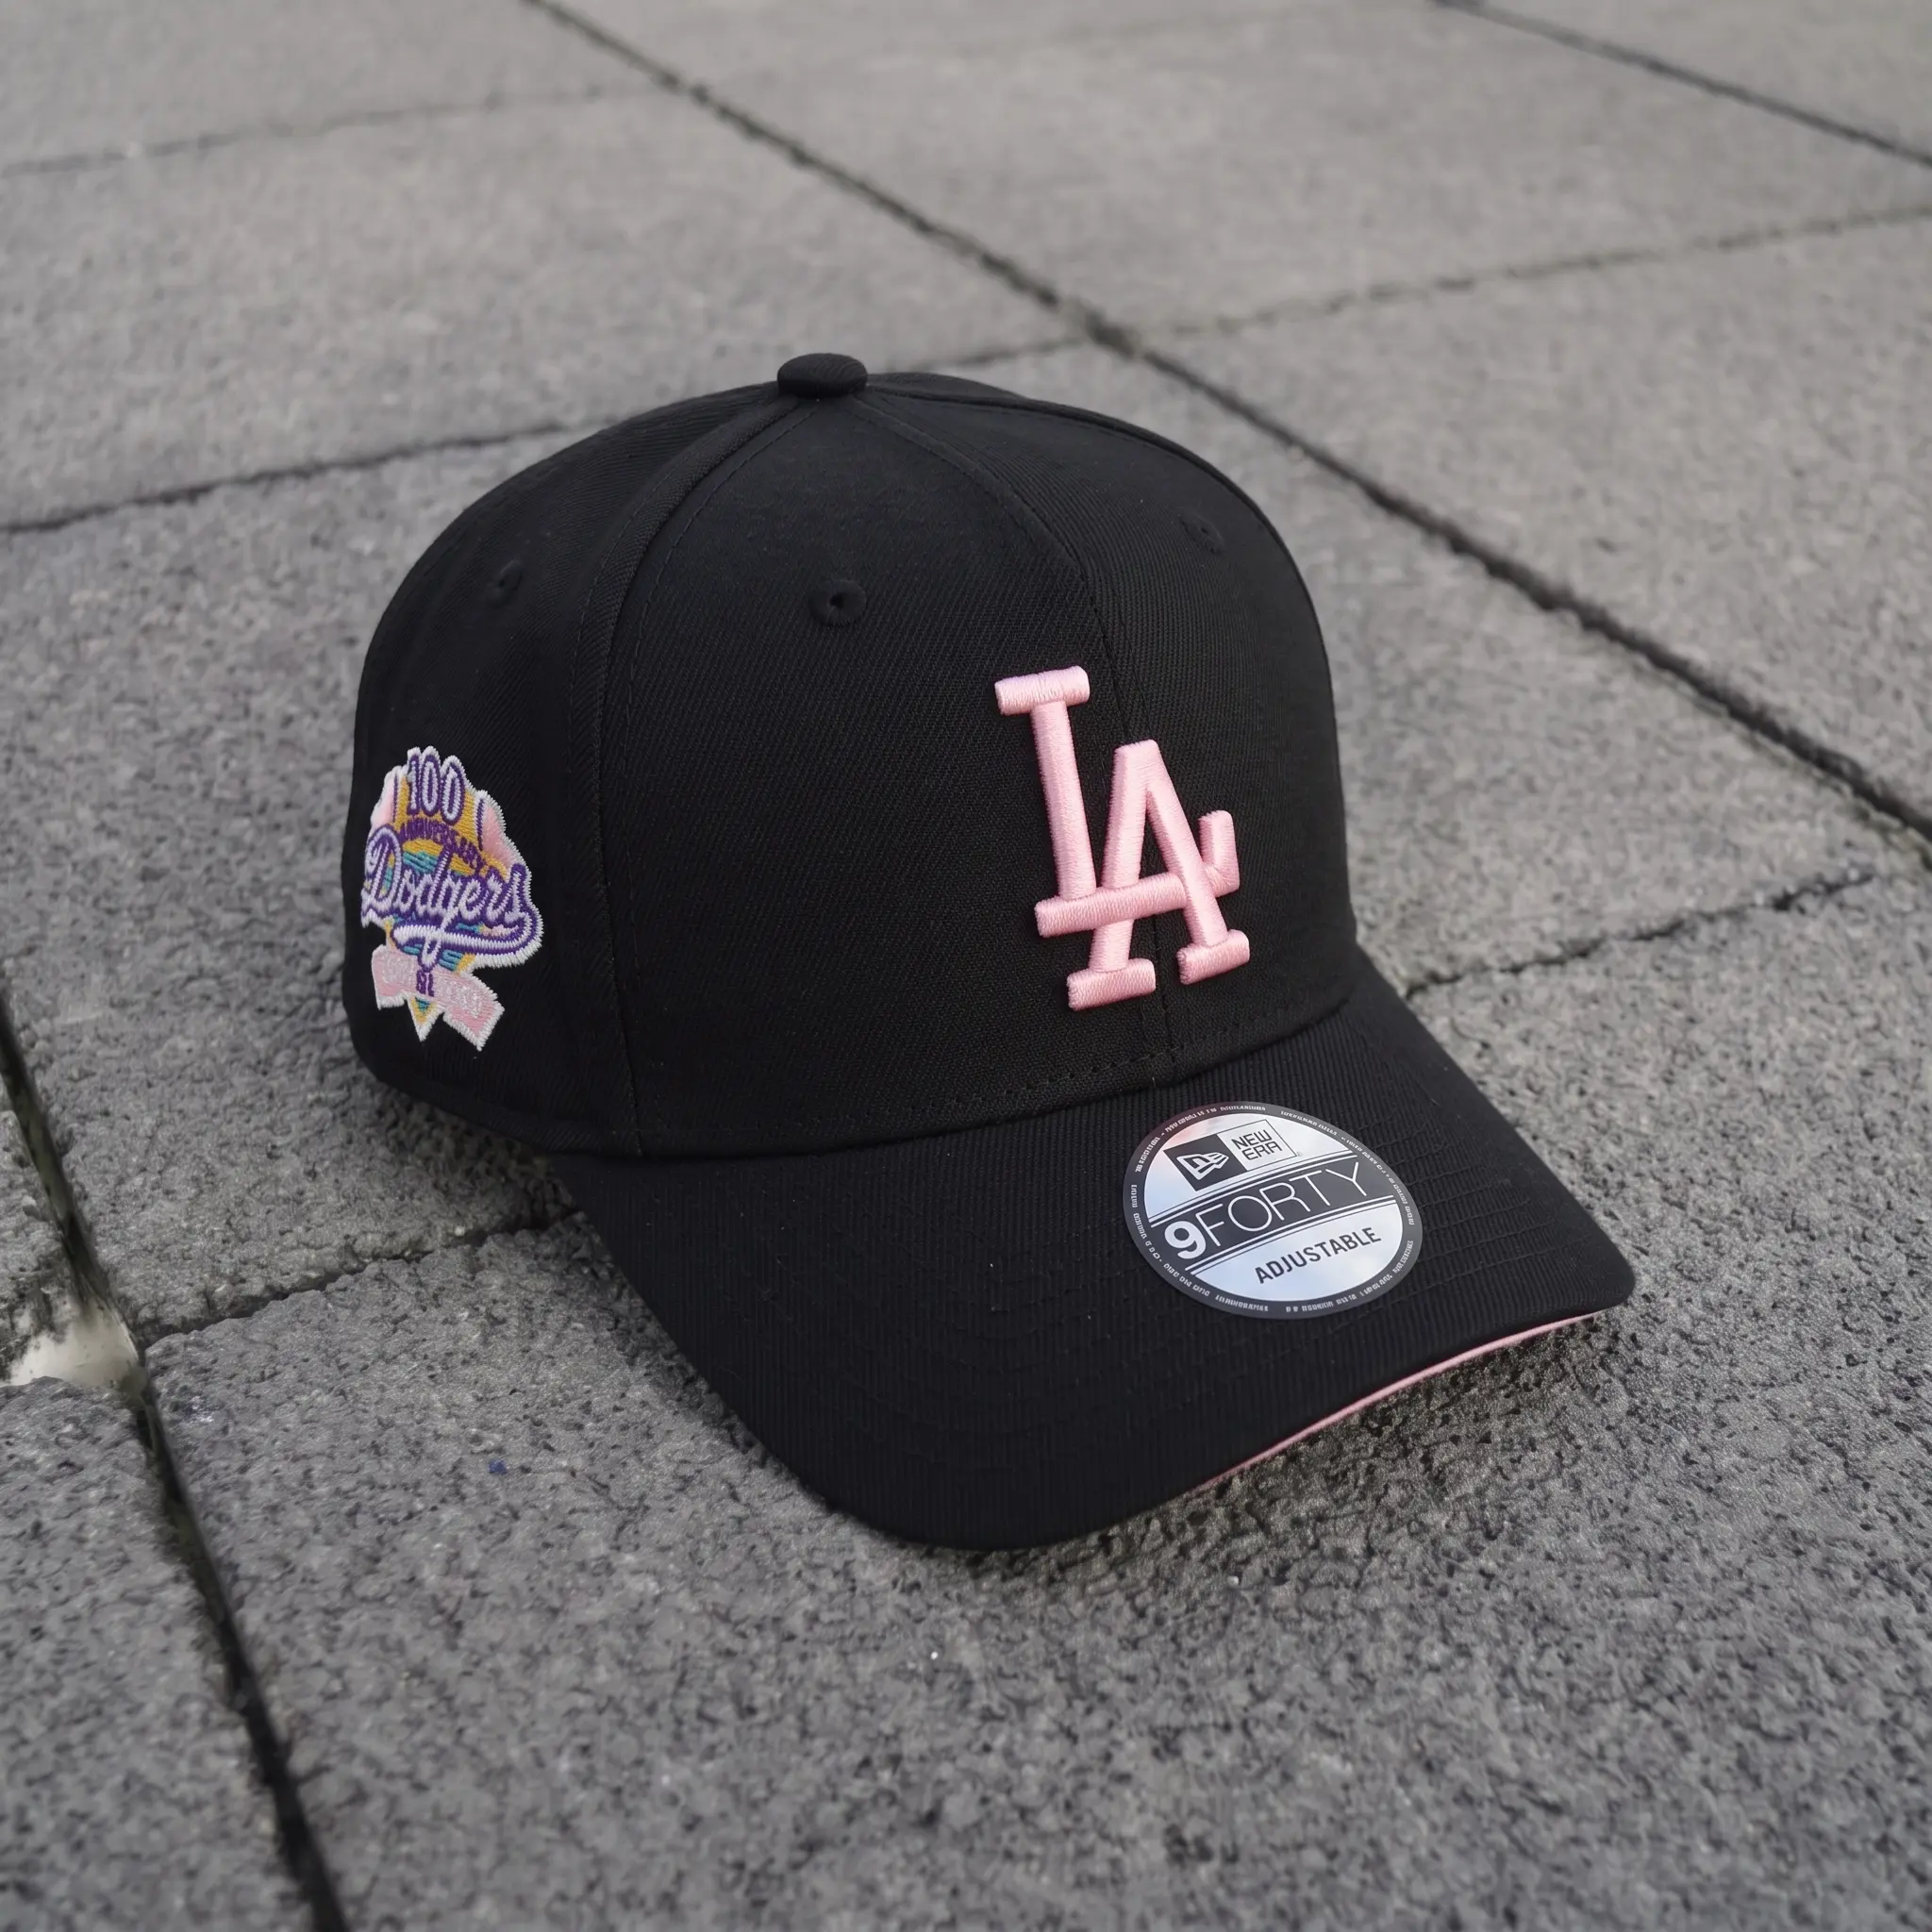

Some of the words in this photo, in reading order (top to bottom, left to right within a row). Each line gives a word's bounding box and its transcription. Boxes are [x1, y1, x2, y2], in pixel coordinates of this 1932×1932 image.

[406, 754, 465, 825] 100
[994, 665, 1251, 1011] LA
[362, 824, 542, 971] Dodgers
[1231, 1129, 1273, 1150] NEW
[1241, 1141, 1283, 1161] ERA
[1164, 1161, 1368, 1259] 9FORTY
[1255, 1226, 1382, 1284] ADJUSTABLE
